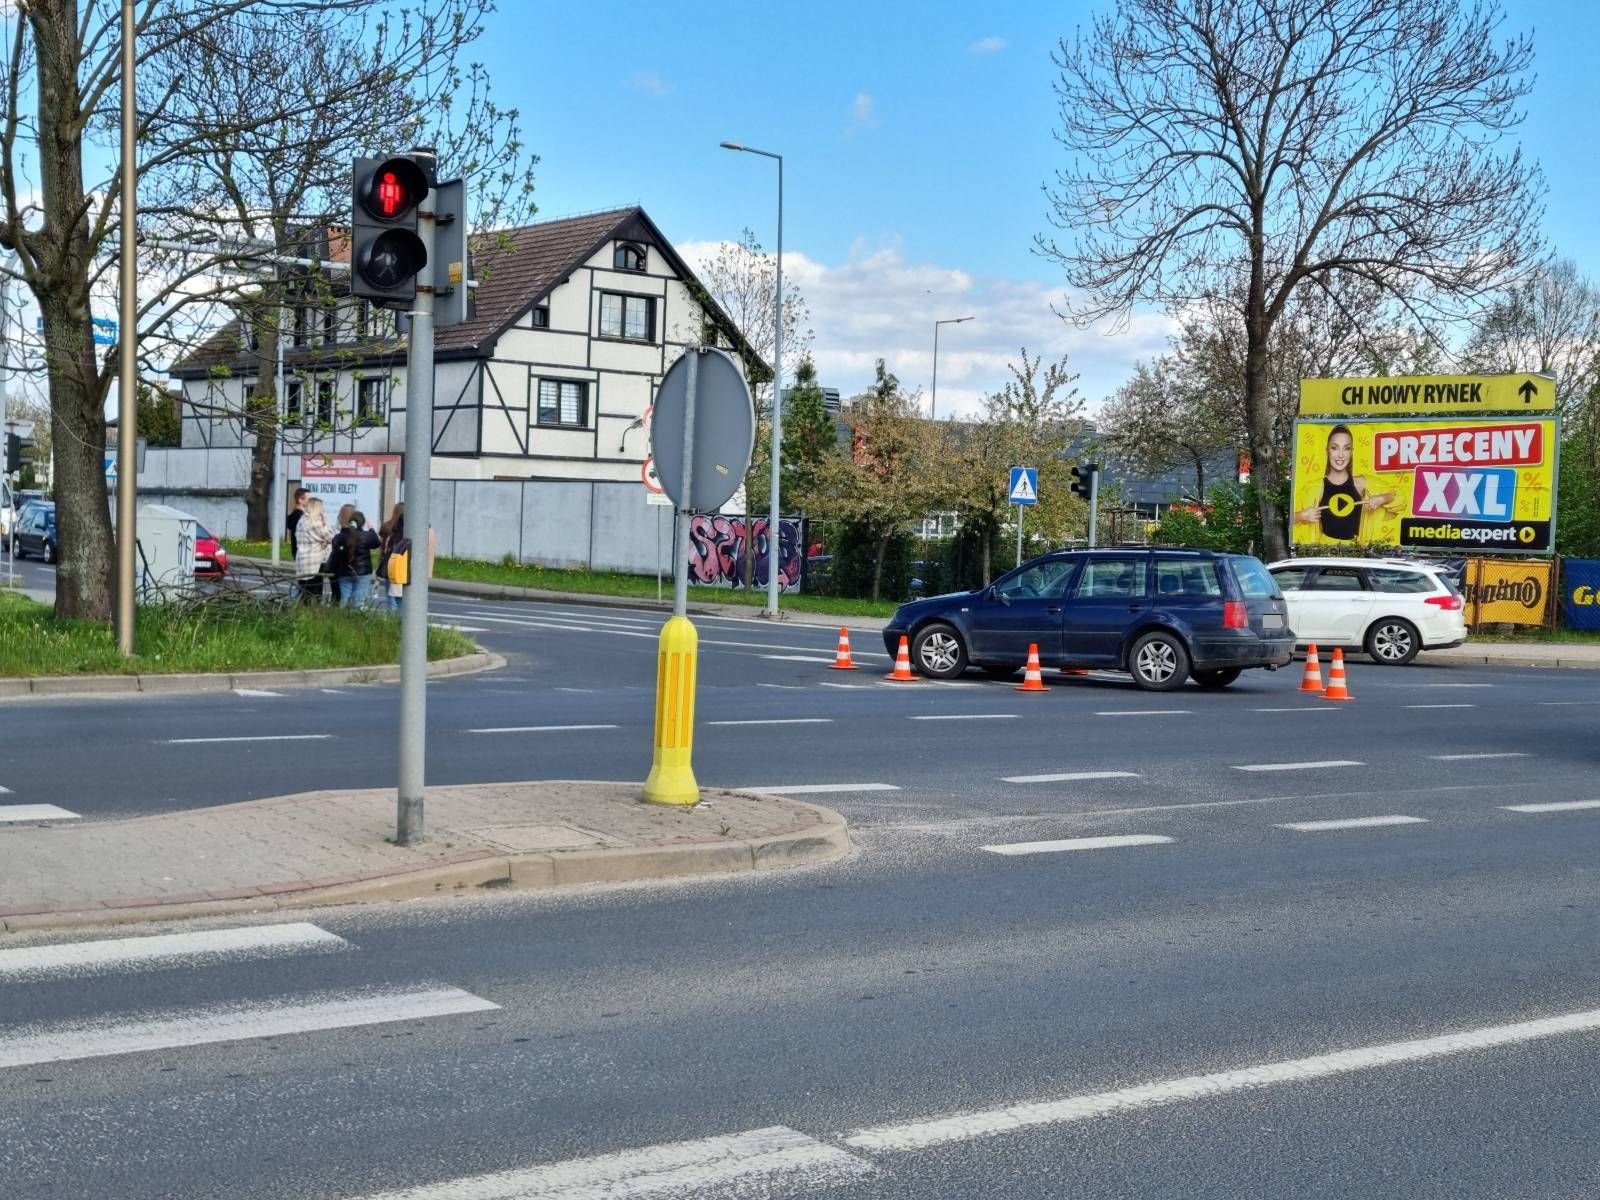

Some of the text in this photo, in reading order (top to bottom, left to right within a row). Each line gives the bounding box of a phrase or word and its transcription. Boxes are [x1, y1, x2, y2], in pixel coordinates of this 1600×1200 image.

[1341, 382, 1482, 406] CH NOWY RYNEK
[1379, 428, 1537, 466] PRZECENY
[338, 483, 357, 494] ROLETY
[1418, 471, 1507, 516] XXL
[1408, 524, 1517, 544] mediaexpert
